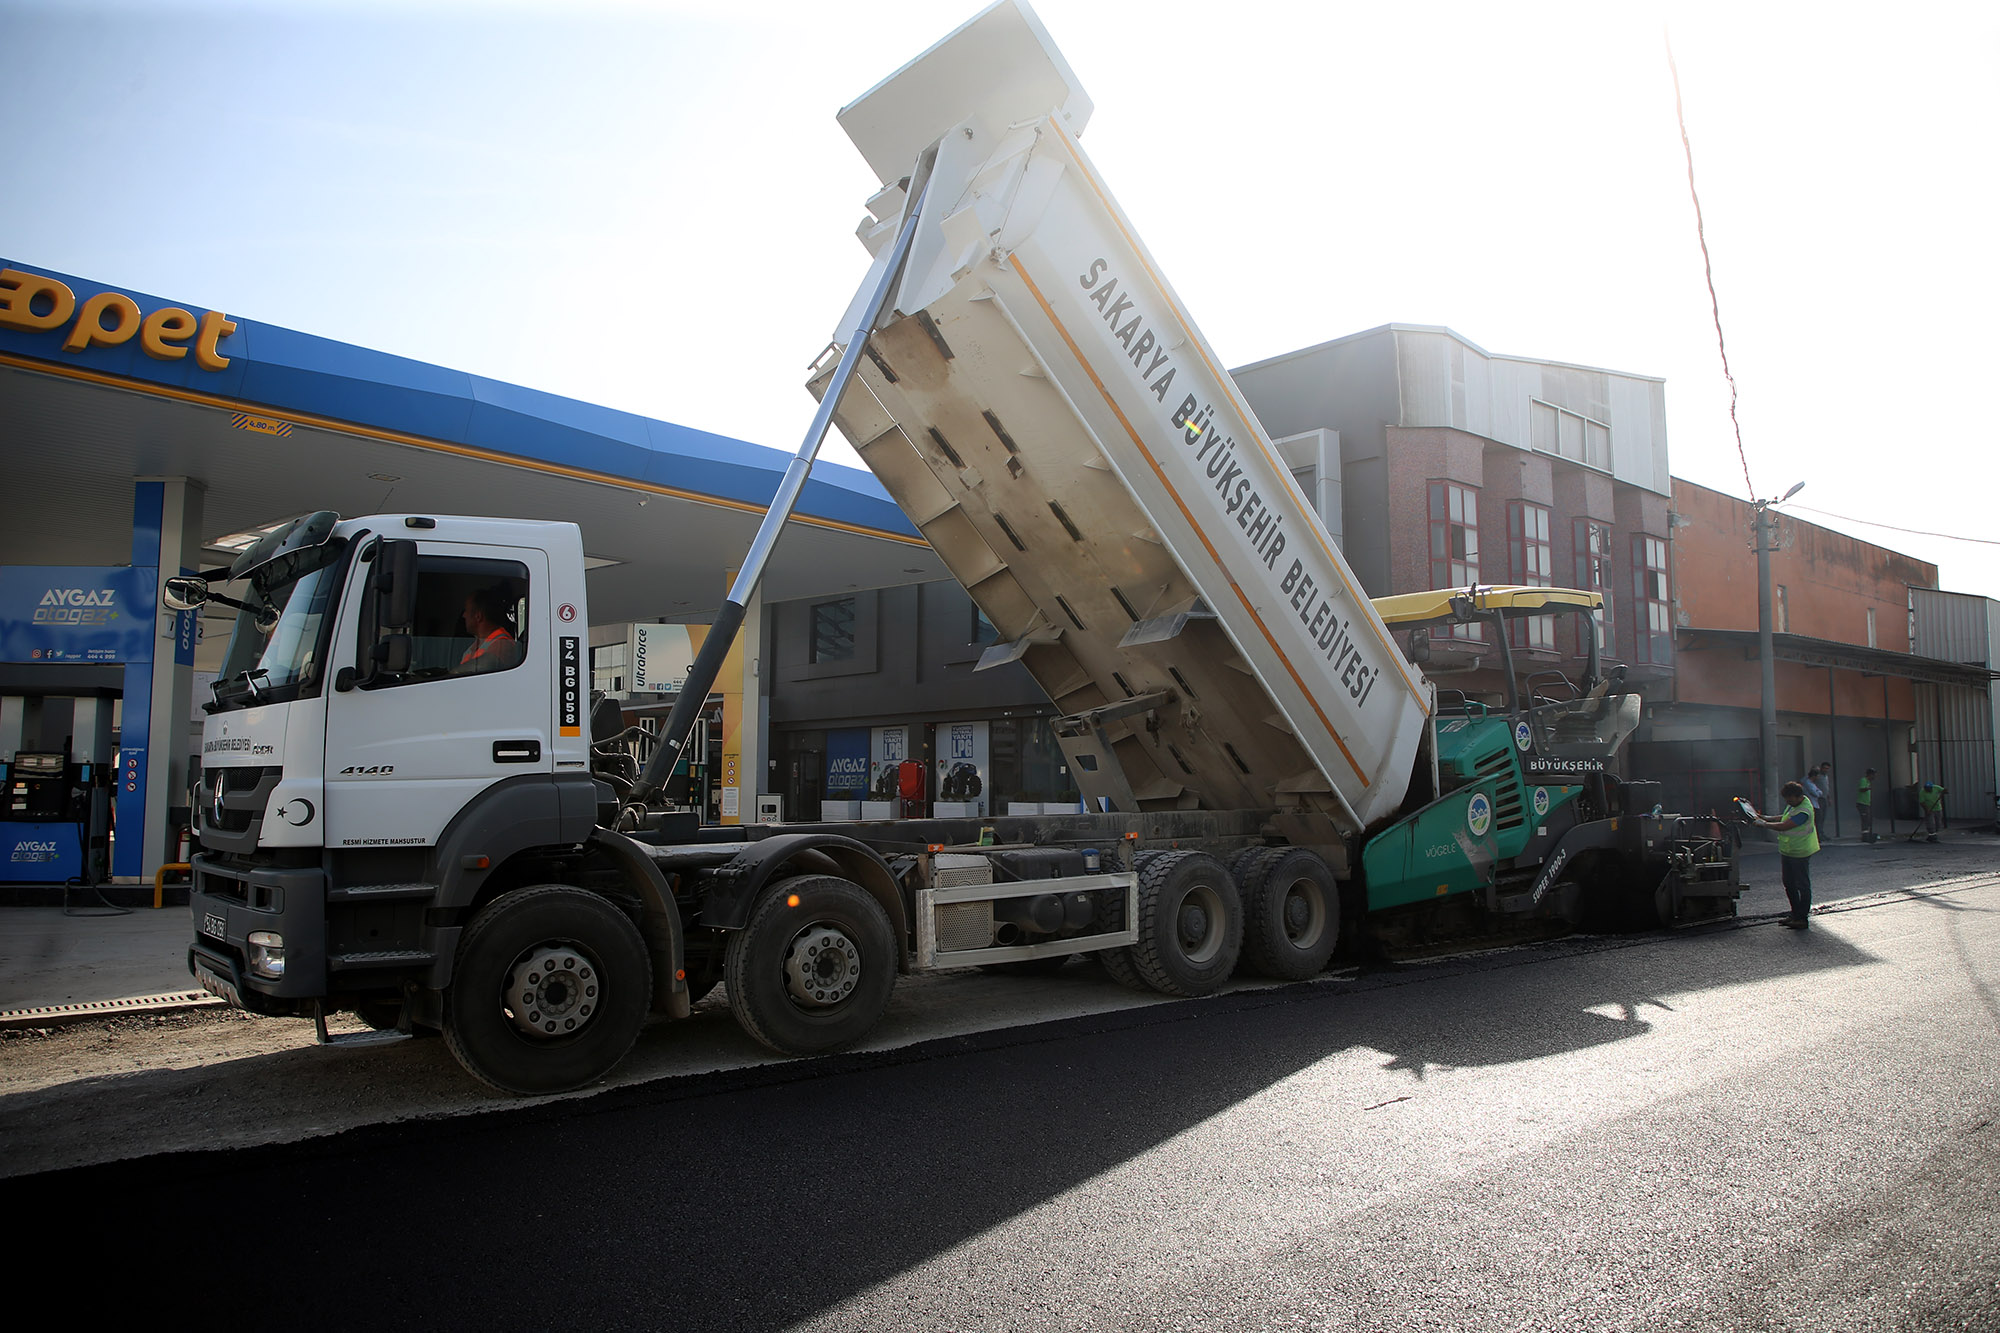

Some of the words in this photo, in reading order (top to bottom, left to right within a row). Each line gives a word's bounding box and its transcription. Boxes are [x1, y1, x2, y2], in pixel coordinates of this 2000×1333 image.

[1080, 258, 1176, 403] SAKARYA
[1171, 393, 1286, 571] BÜYÜKŞEHİR
[1280, 558, 1379, 708] BELEDİYESİ
[40, 589, 115, 606] AYGAZ
[562, 607, 572, 620] 6
[198, 628, 203, 638] 2
[565, 640, 575, 660] 54
[565, 666, 576, 687] BG
[565, 691, 575, 724] 058
[884, 743, 902, 760] LPG
[953, 740, 973, 758] LPG
[339, 766, 394, 776] 4140
[830, 758, 866, 773] AYGAZ
[1530, 758, 1604, 771] BÜYÜKŞEHİR
[14, 841, 56, 851] AYGAZ
[390, 837, 426, 845] MAHSUSTUR
[1425, 843, 1456, 857] VÖGELE
[1533, 876, 1550, 903] SUPER
[1549, 849, 1567, 878] 1900-3
